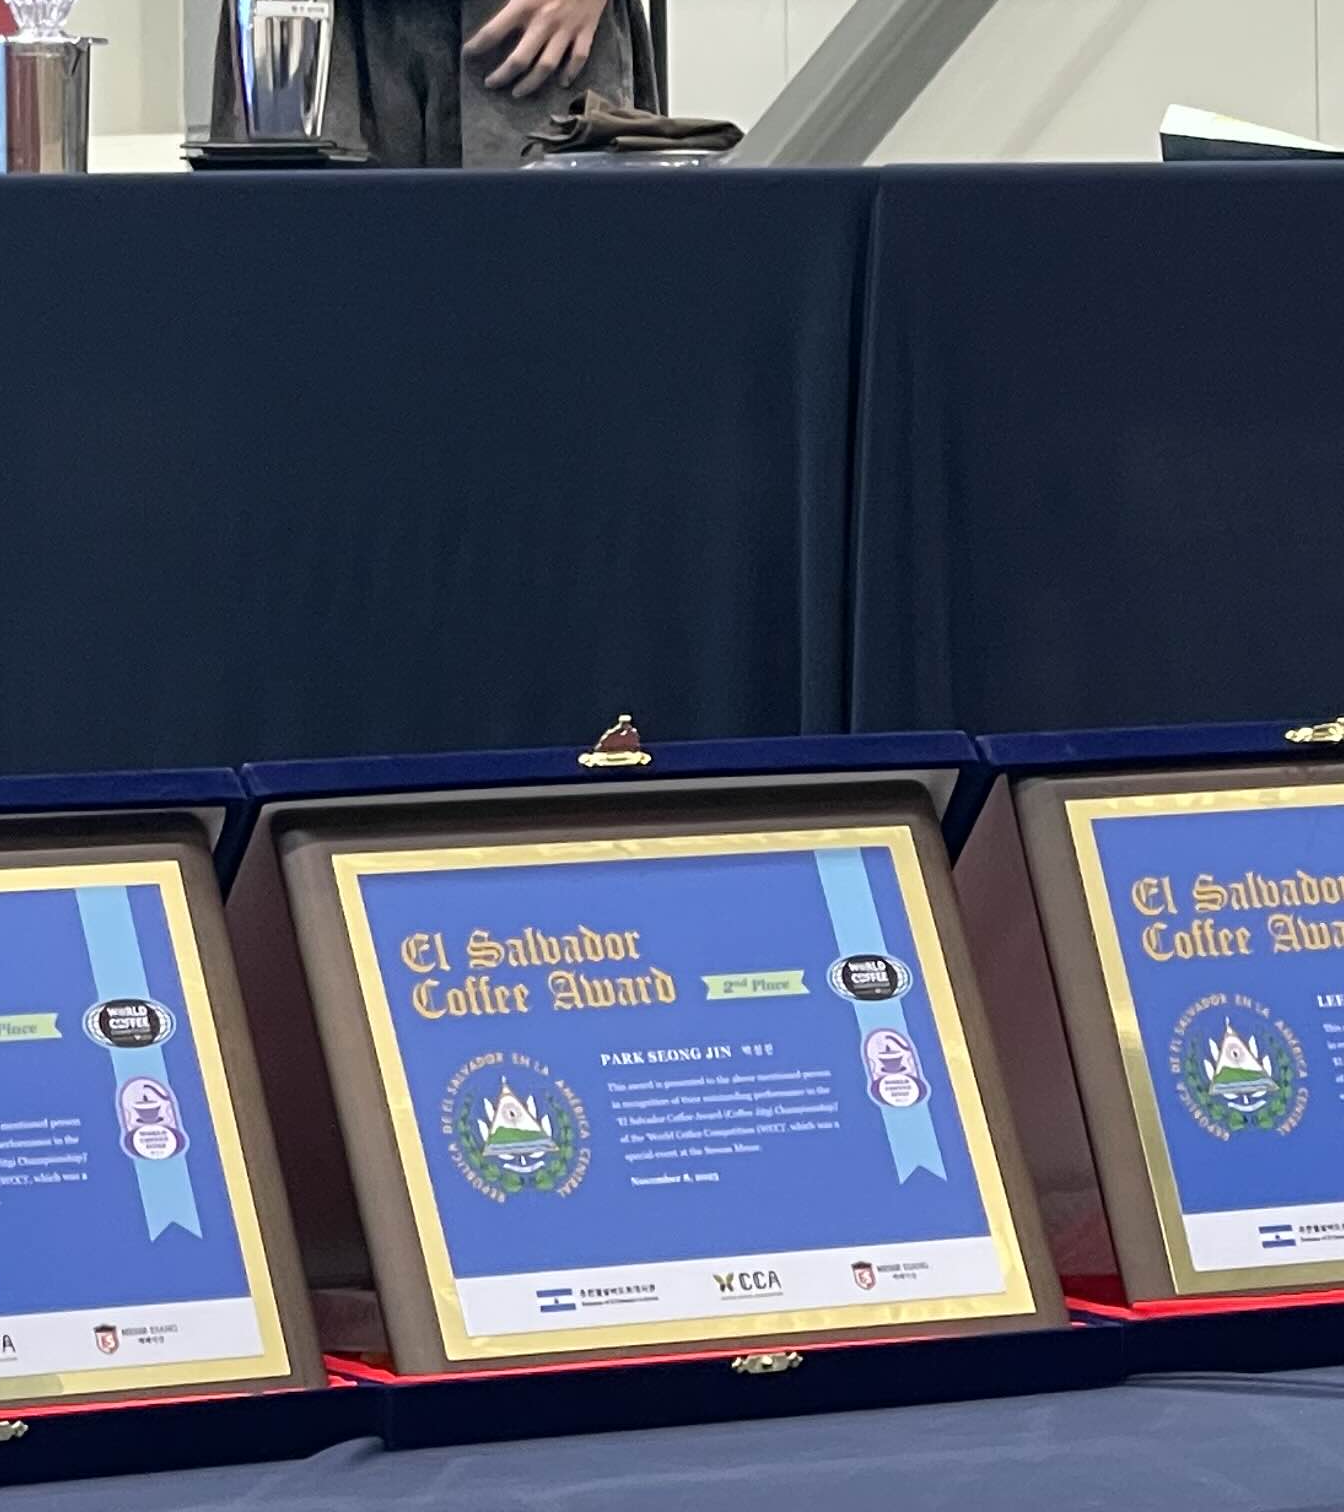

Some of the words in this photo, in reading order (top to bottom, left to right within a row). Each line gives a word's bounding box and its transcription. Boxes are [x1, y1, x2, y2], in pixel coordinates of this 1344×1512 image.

[1131, 876, 1176, 917] El
[401, 932, 451, 974] El
[467, 925, 641, 969] Salvador
[1143, 918, 1252, 963] Coffee
[412, 975, 531, 1020] Coffee
[548, 966, 678, 1012] Award
[752, 978, 790, 992] Place
[107, 1006, 147, 1017] WORLD
[108, 1017, 150, 1029] COFFEE
[601, 1051, 644, 1066] PARK
[648, 1048, 702, 1063] SEONG
[705, 1046, 733, 1060] JIN
